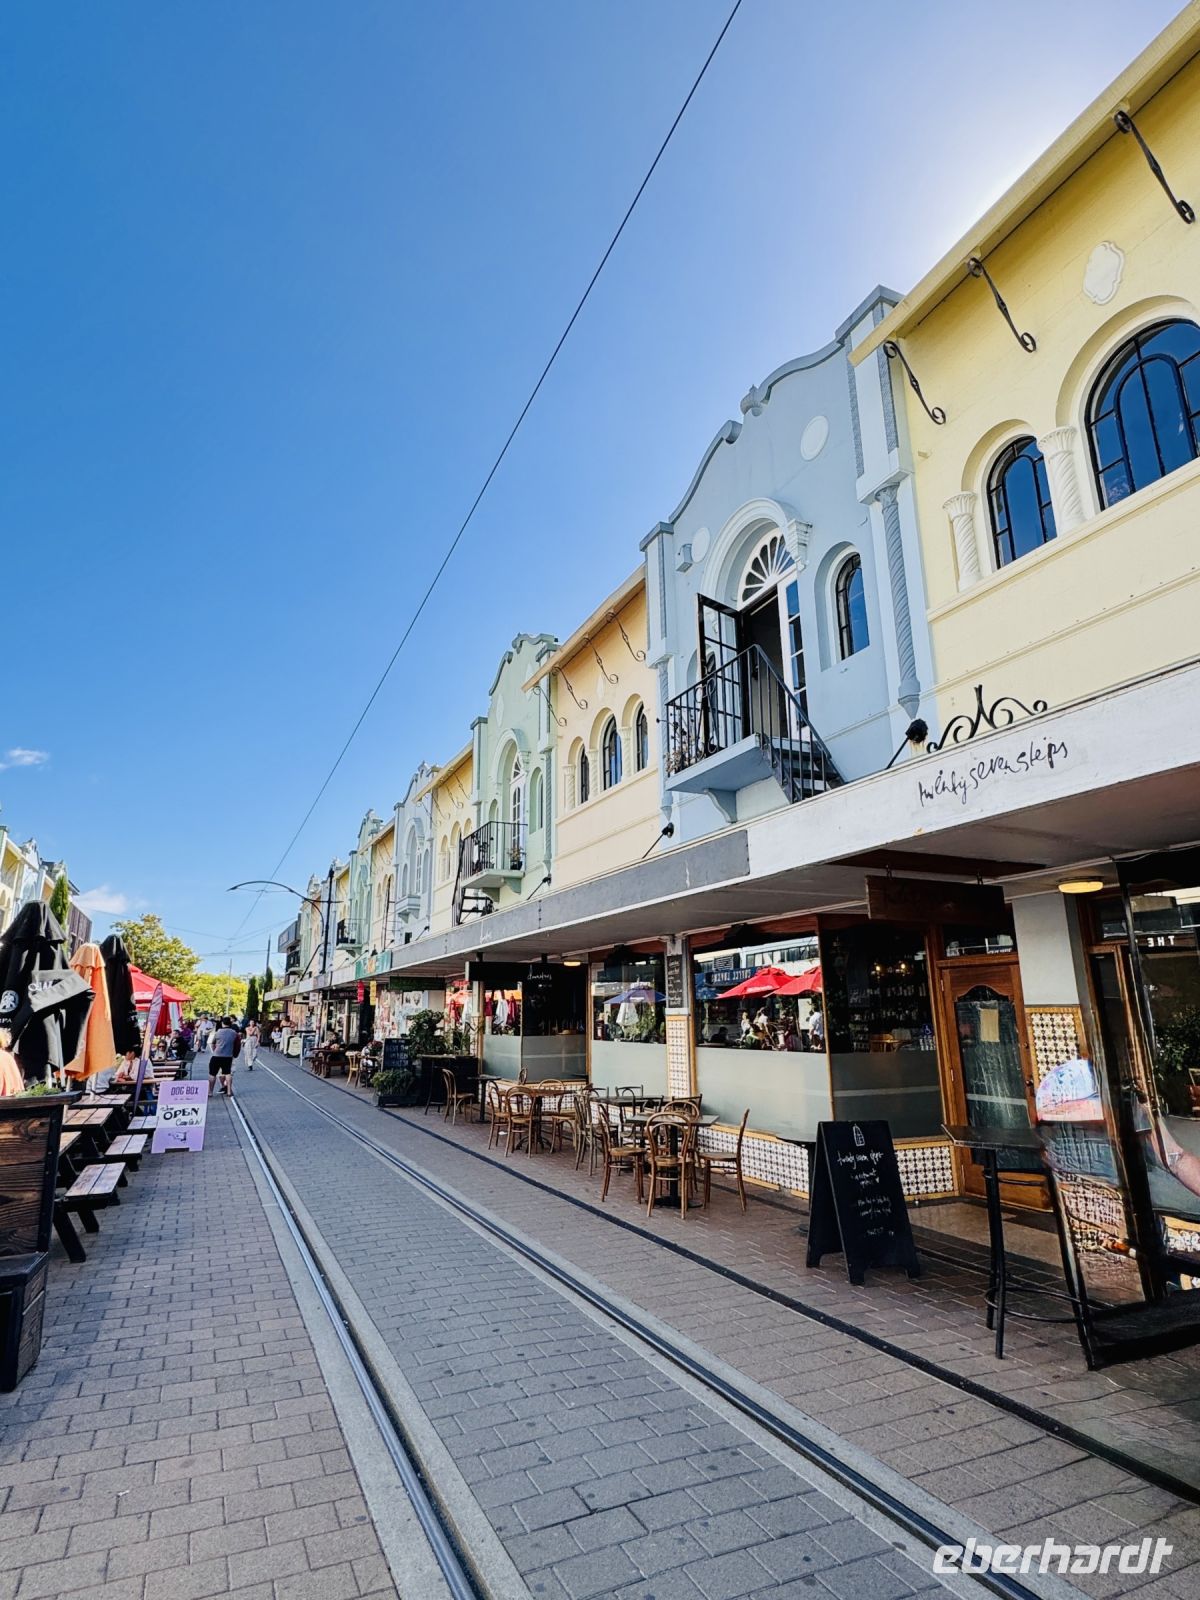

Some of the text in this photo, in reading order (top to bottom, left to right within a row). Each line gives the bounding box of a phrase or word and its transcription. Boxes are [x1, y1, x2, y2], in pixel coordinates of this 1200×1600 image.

[171, 1086, 200, 1096] DOG BOX
[163, 1107, 200, 1120] OPEN
